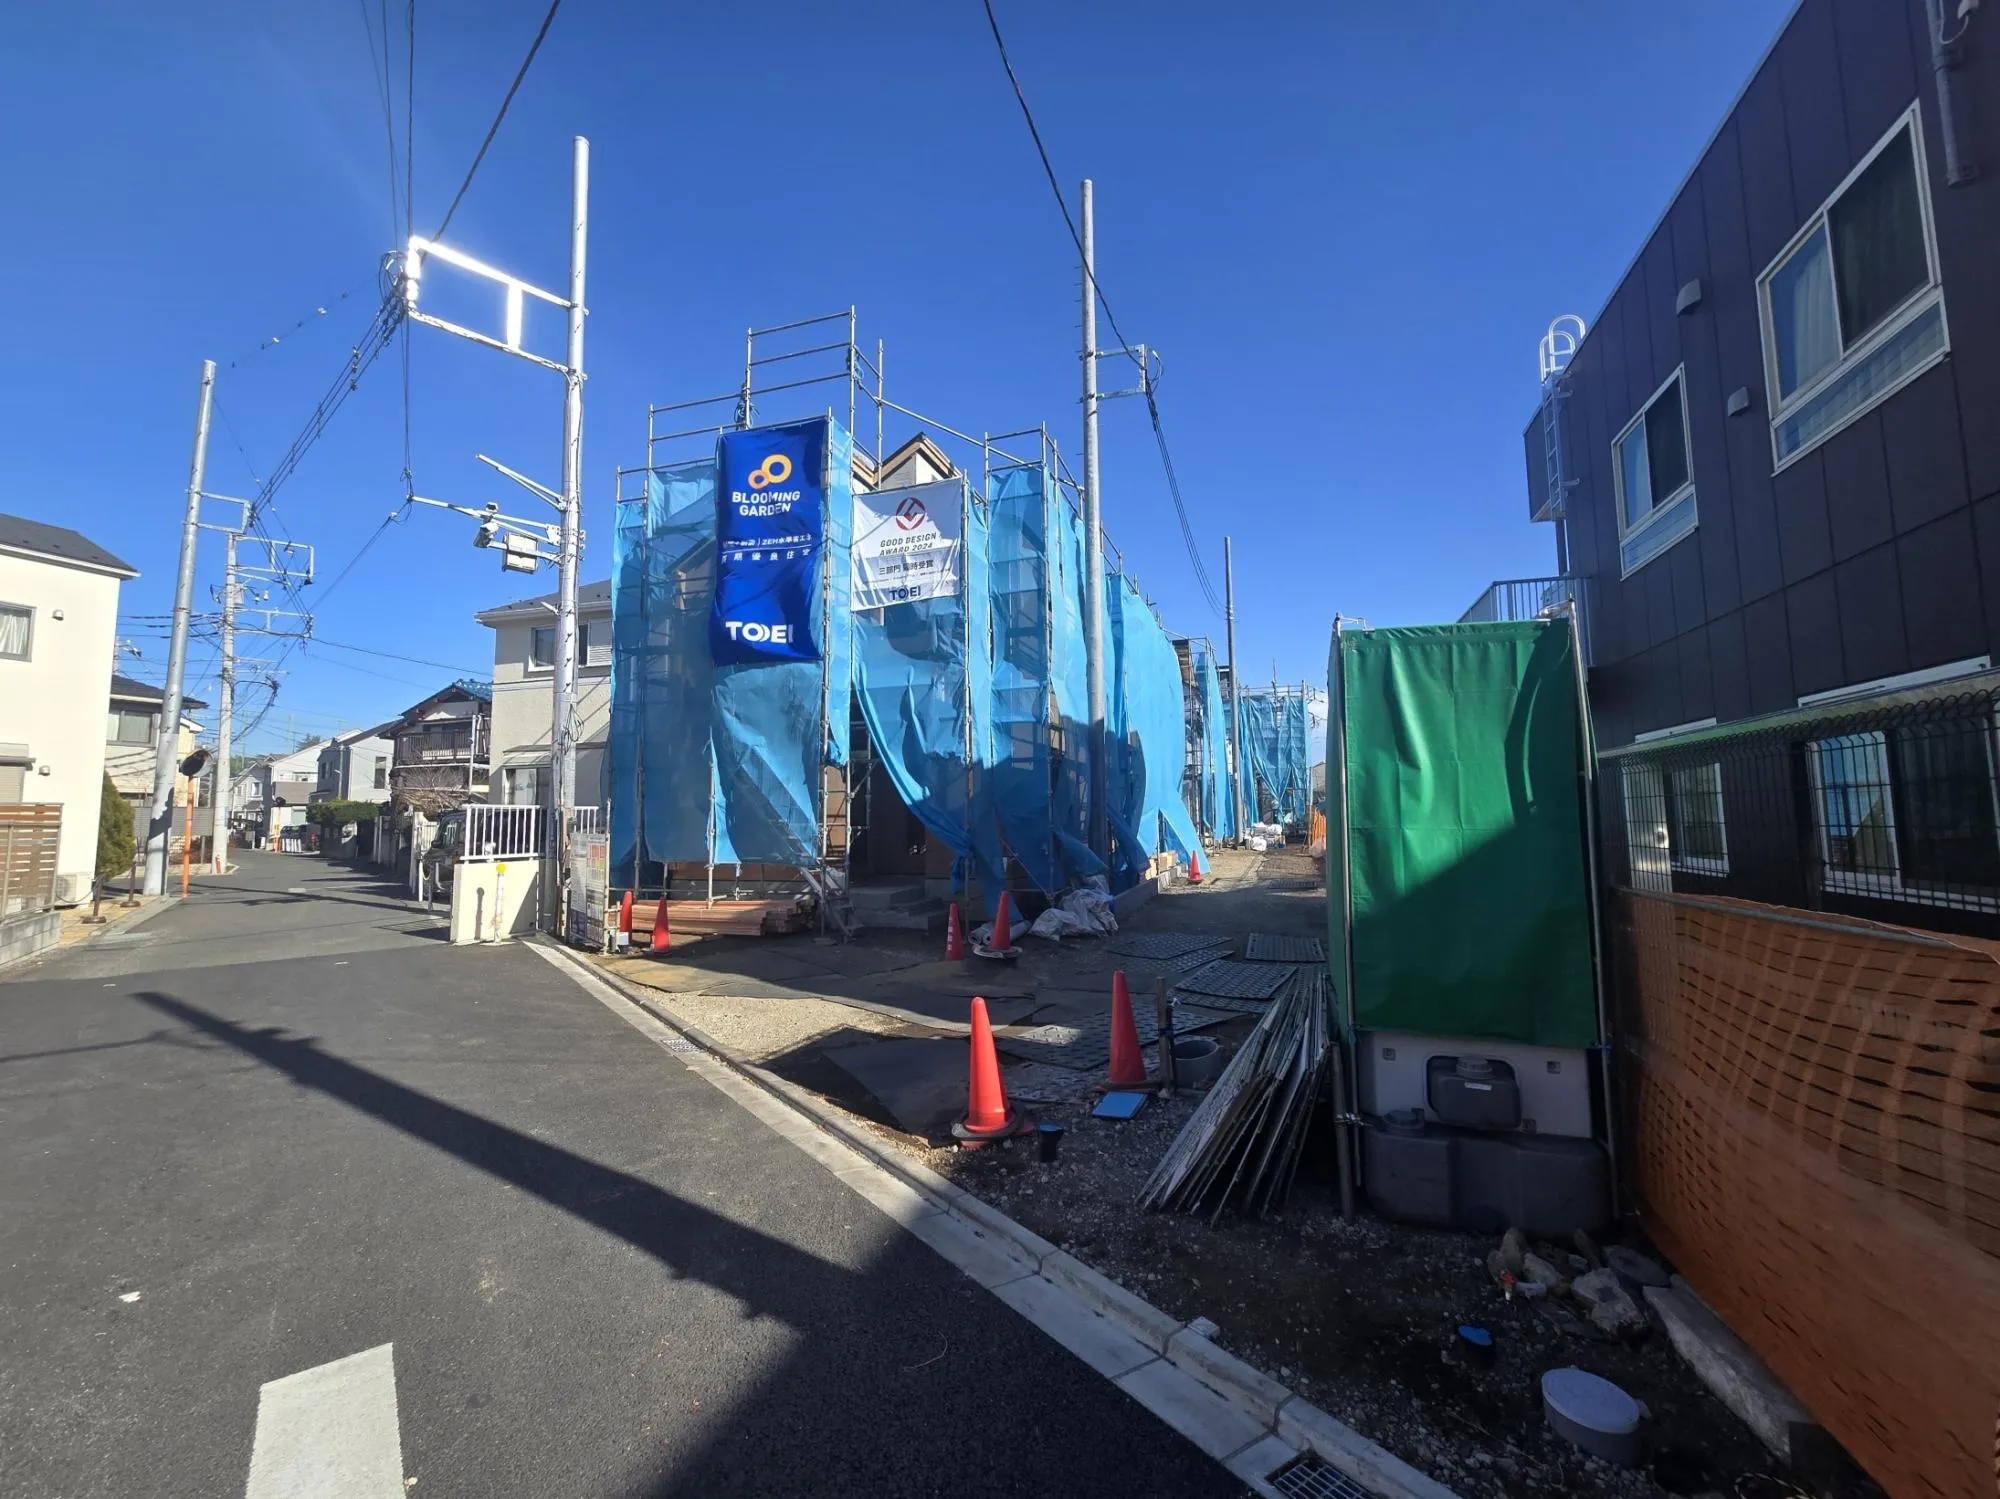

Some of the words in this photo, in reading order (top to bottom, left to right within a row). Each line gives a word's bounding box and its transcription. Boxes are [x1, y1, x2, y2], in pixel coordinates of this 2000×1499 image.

[732, 490, 801, 504] BLOOMING
[739, 502, 792, 517] GARDEN
[880, 537, 904, 548] GOOD
[905, 532, 937, 544] DESIGN
[879, 546, 910, 556] AWARD
[912, 542, 933, 552] 2024
[888, 585, 922, 601] TOEI
[725, 621, 794, 644] TOEI
